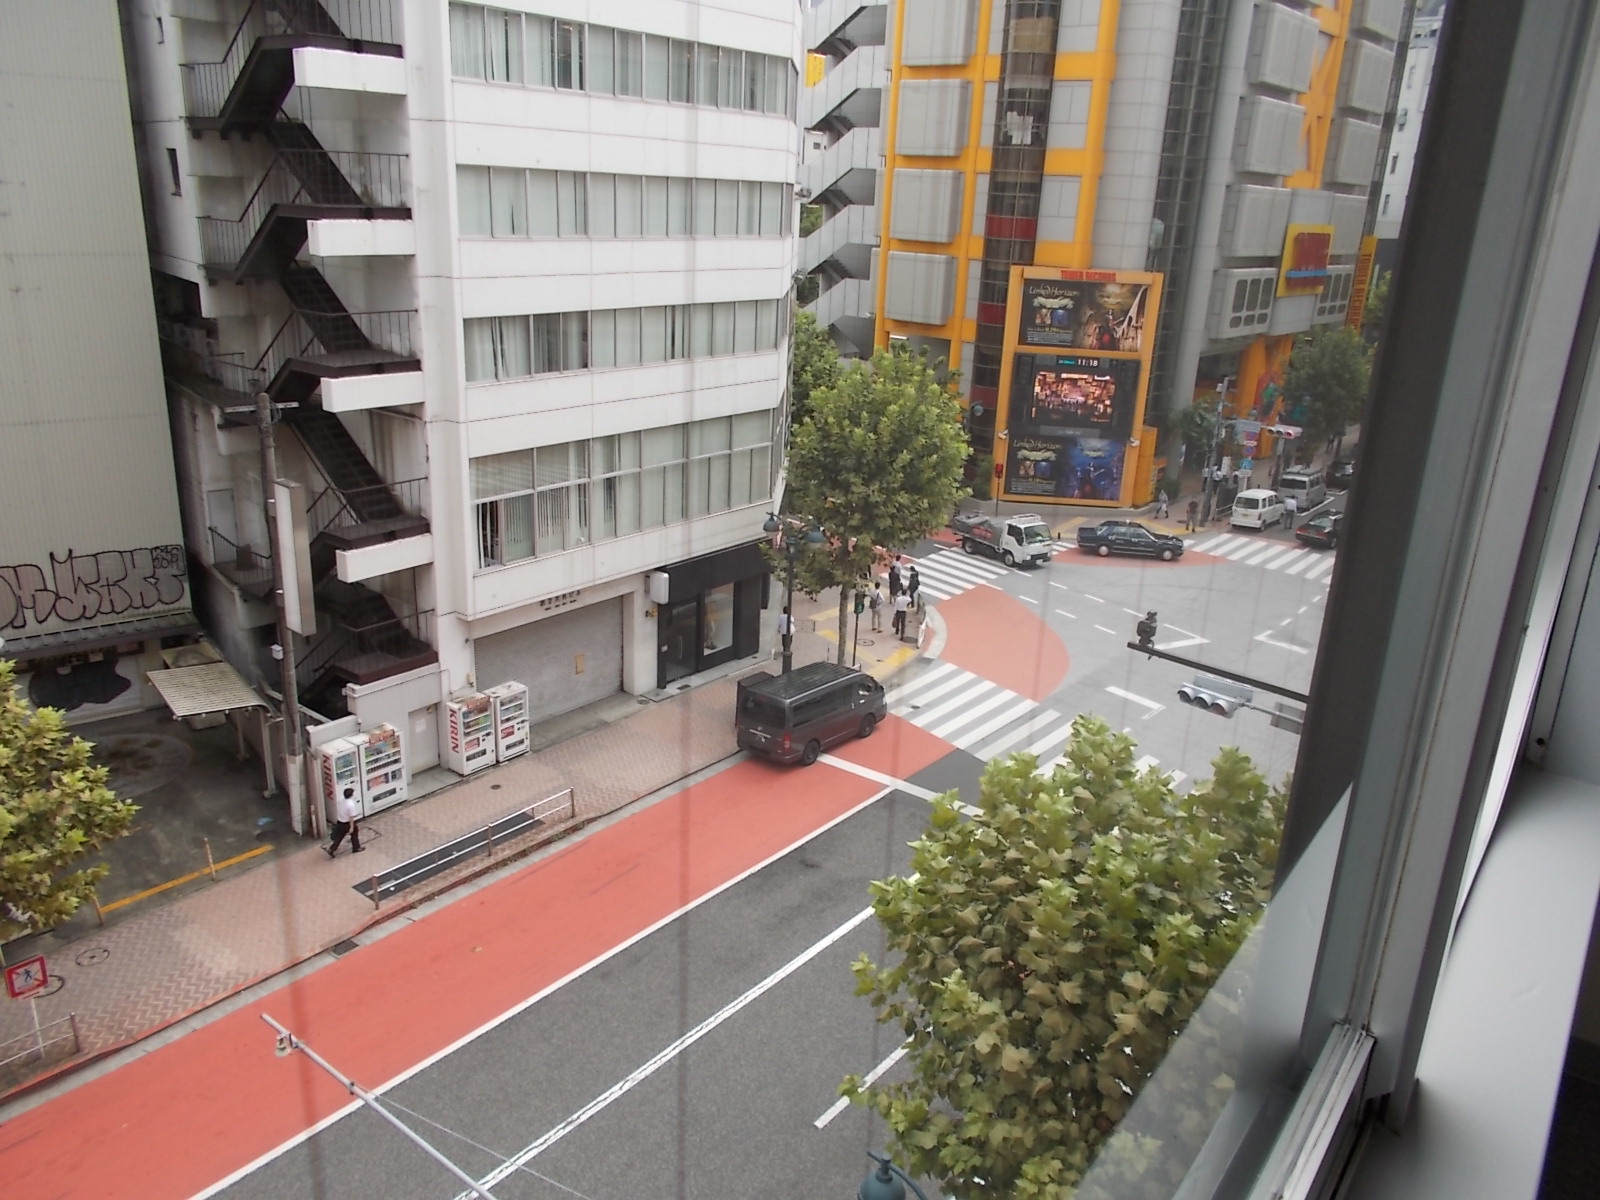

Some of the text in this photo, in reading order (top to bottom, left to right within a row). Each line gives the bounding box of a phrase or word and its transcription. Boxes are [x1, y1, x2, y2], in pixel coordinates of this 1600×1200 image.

[1061, 270, 1116, 282] TOWER RECORDS
[1077, 359, 1098, 367] 11:18
[449, 708, 460, 754] KIRIN
[322, 754, 334, 800] KIRIN
